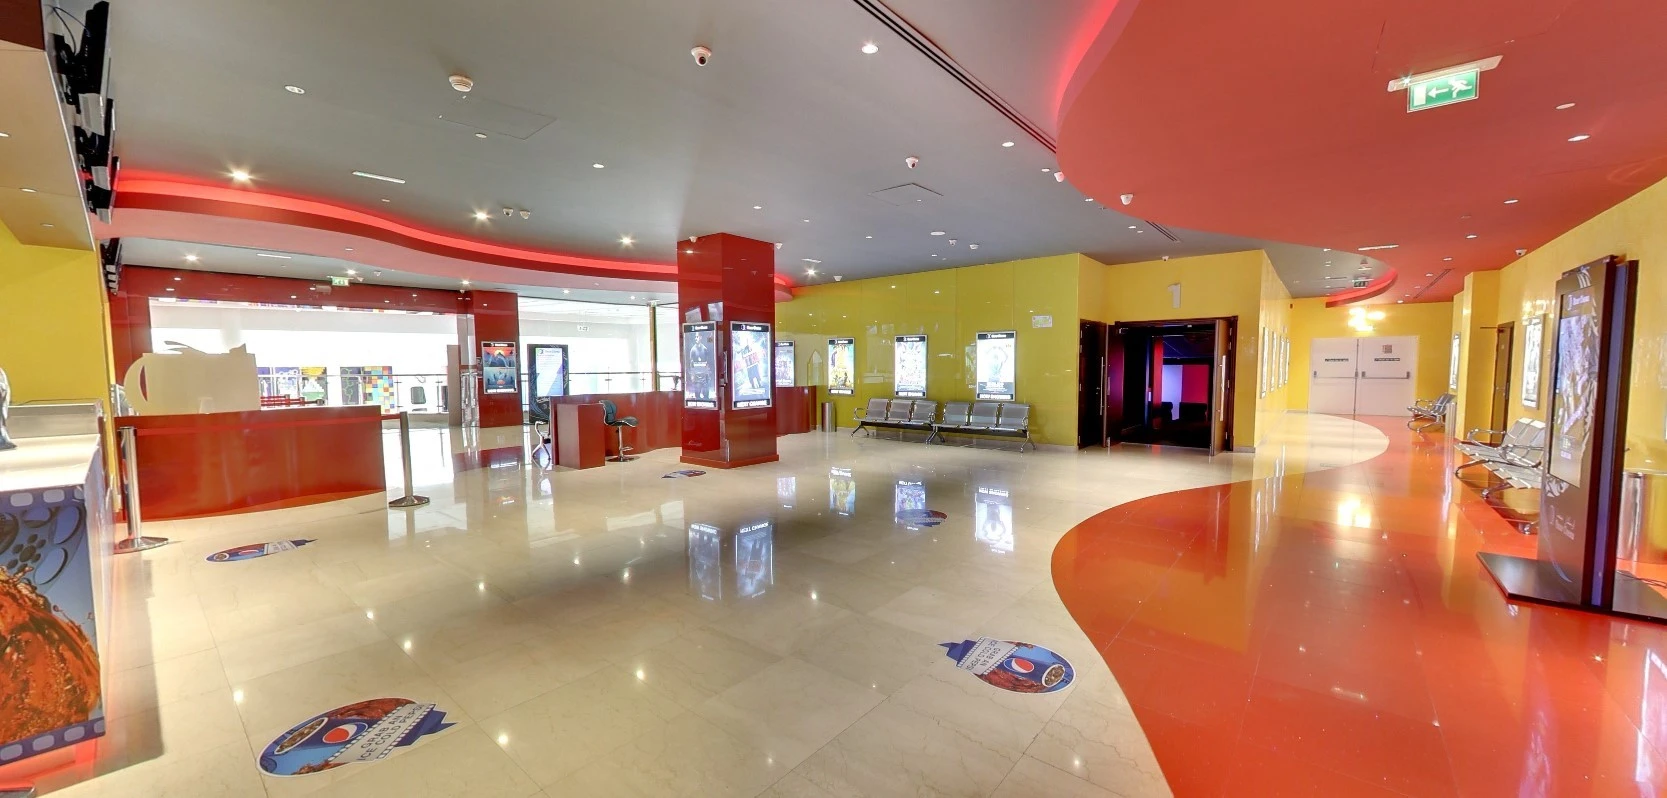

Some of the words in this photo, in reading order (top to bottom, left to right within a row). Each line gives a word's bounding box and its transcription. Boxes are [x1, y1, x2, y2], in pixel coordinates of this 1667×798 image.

[356, 747, 377, 761] ICE
[375, 725, 401, 745] COLD
[361, 727, 389, 748] GRAB
[389, 715, 402, 725] AN
